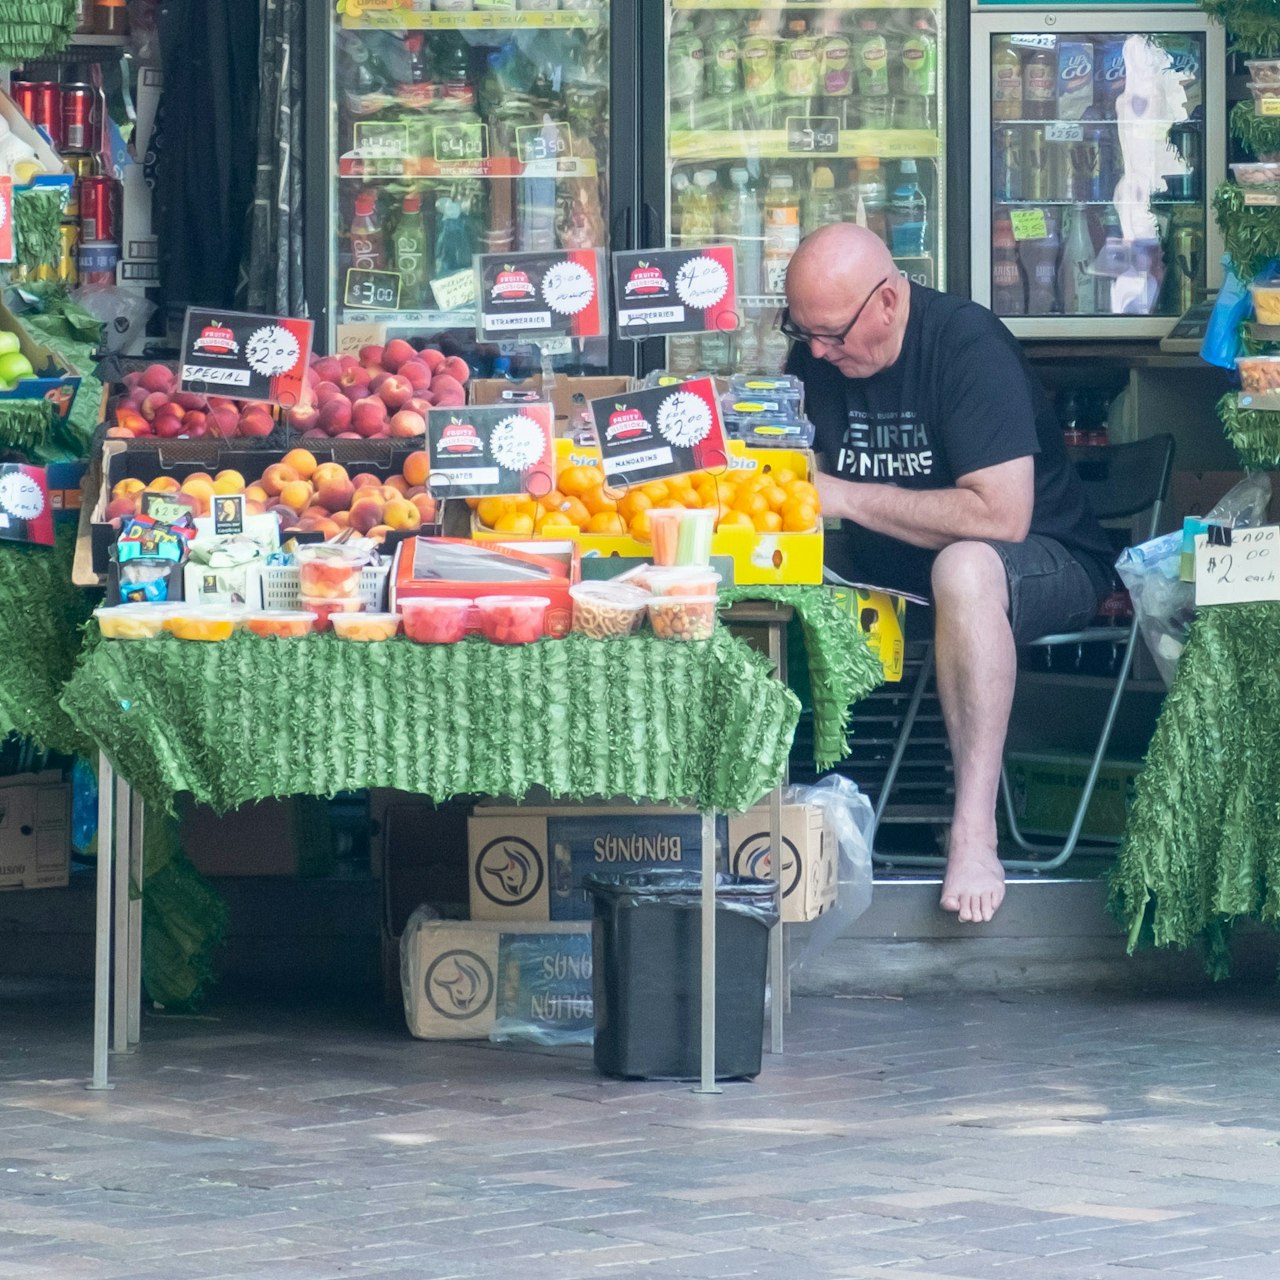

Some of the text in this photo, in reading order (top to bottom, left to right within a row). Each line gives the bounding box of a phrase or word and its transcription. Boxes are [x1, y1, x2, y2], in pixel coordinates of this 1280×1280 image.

[1061, 63, 1092, 79] GO
[353, 239, 381, 271] alo
[490, 316, 546, 326] STRAWBERRIES
[627, 309, 675, 320] BLUEBERRIES
[204, 331, 231, 339] FRUITY
[184, 366, 245, 383] SPECIAL
[612, 413, 639, 423] FRUITY
[615, 453, 658, 468] MANDARINS
[449, 472, 473, 480] DATES
[1198, 531, 1275, 550] ACADO
[1244, 571, 1276, 583] each
[593, 836, 682, 863] BANANAS
[543, 954, 593, 979] ANAS
